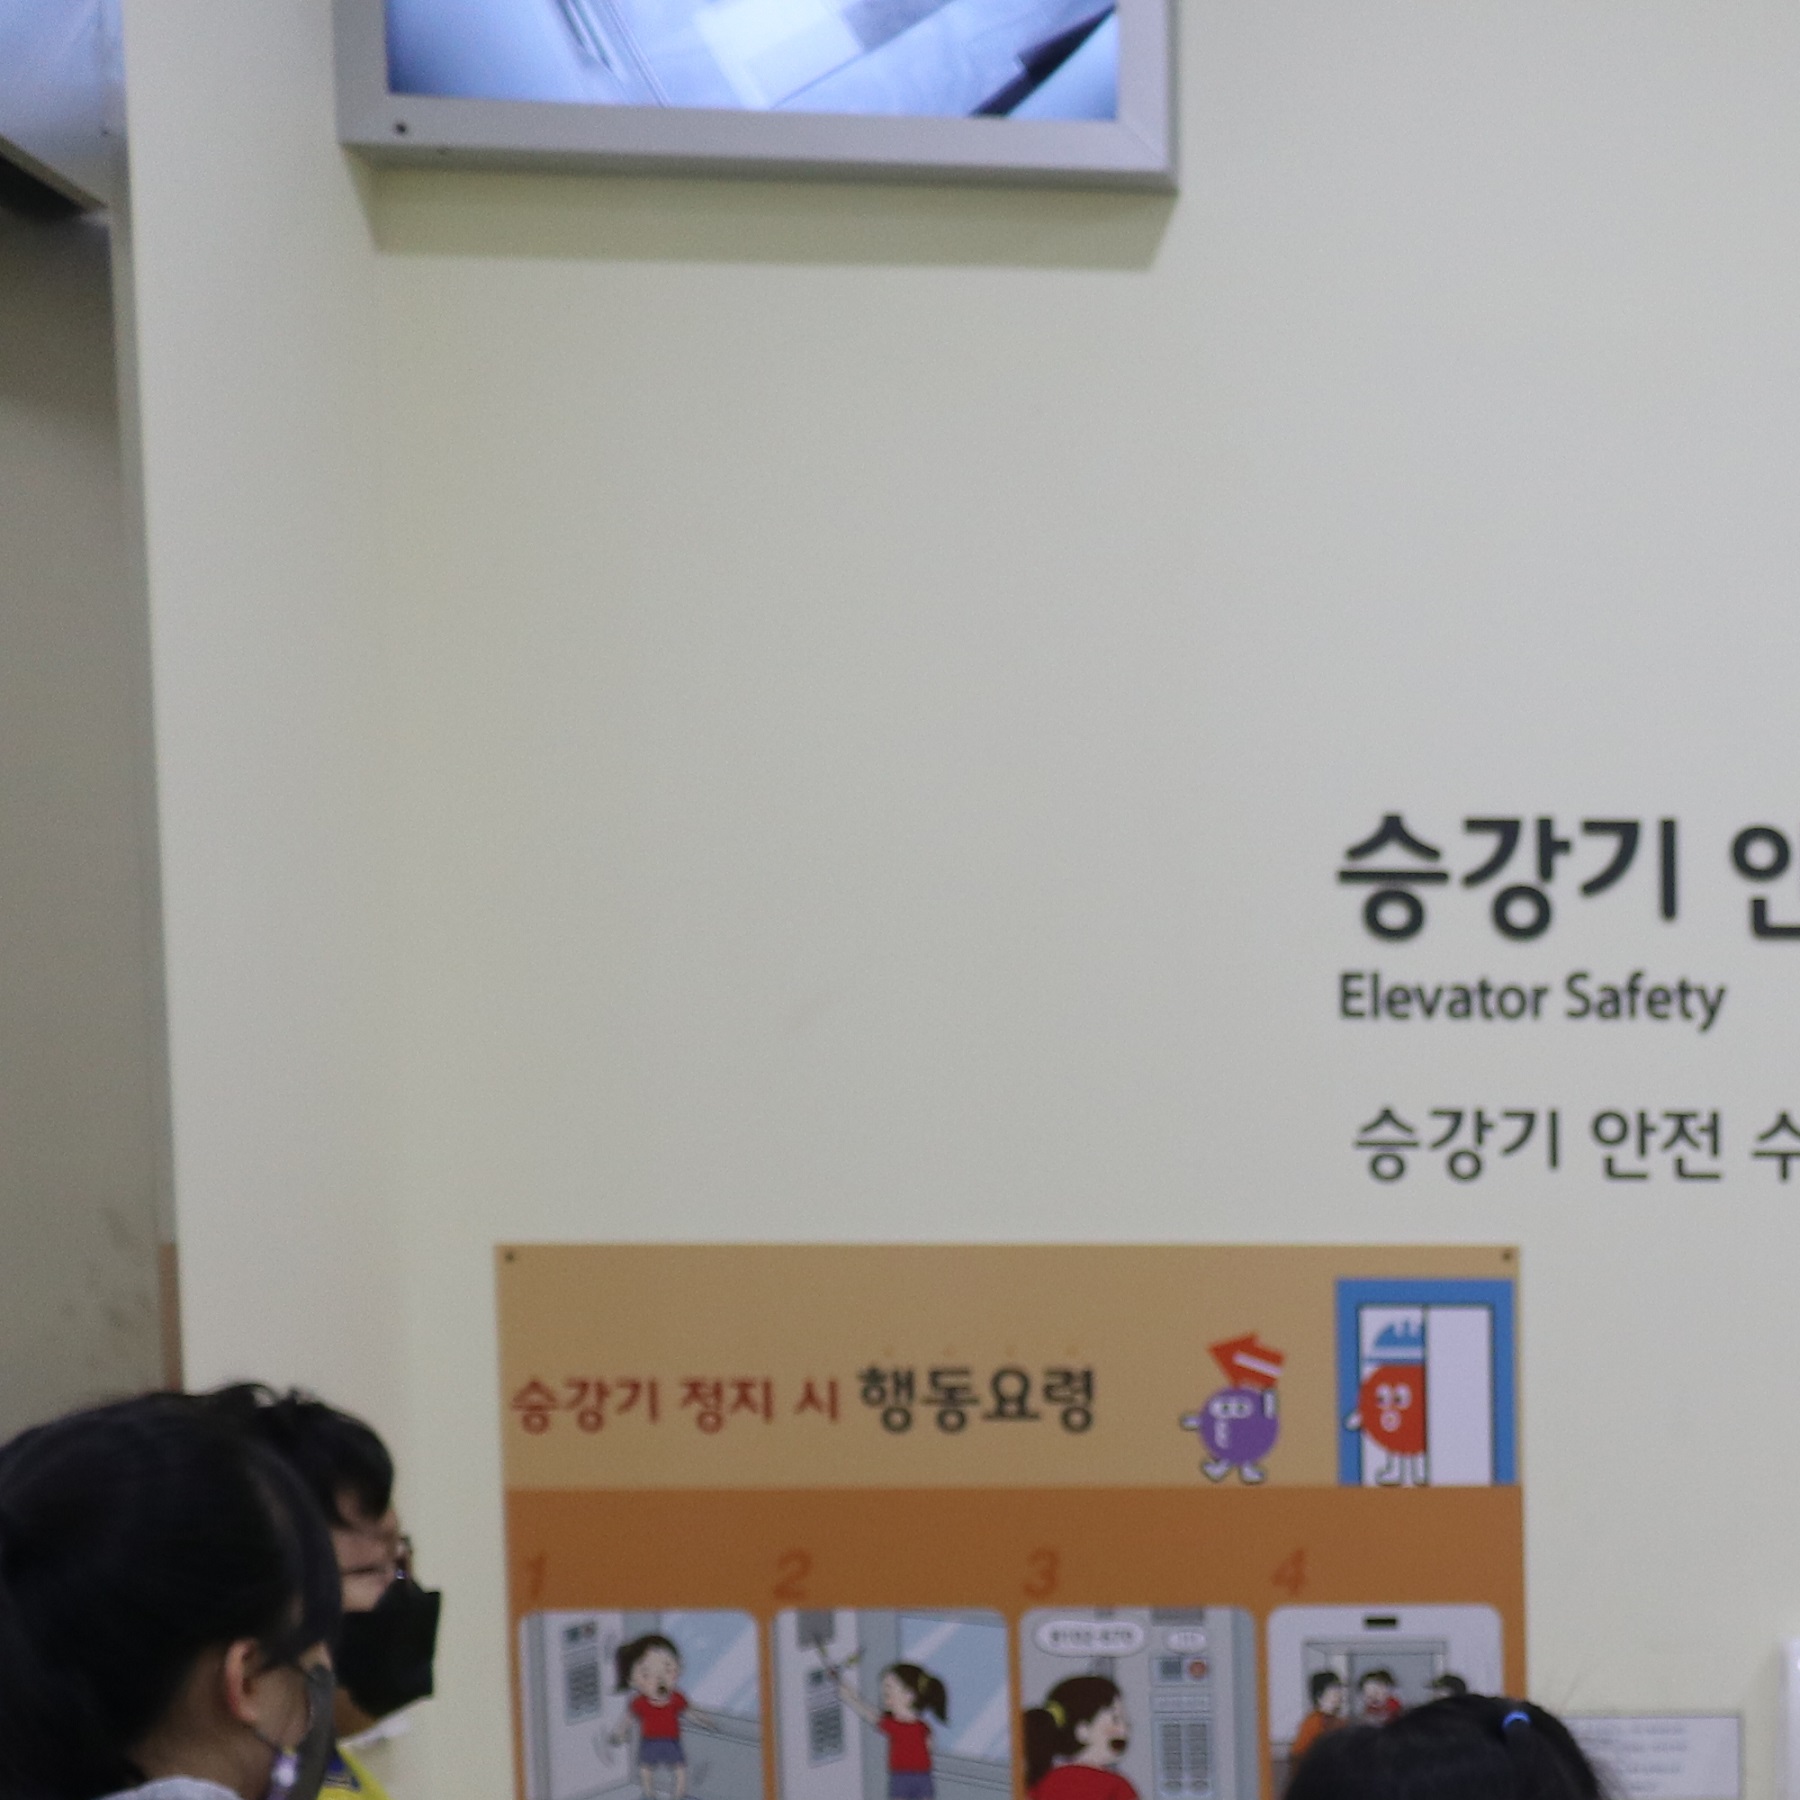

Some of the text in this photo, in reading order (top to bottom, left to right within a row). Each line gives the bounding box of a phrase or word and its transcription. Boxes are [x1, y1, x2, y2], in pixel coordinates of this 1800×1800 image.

[1337, 813, 1678, 943] 승강기
[1340, 970, 1727, 1033] Elevator Safety
[1355, 1107, 1559, 1183] 승강기
[1591, 1109, 1722, 1181] 안전
[512, 1364, 1096, 1435] 승강기 정지 시 행동요령
[526, 1555, 548, 1601] 1
[773, 1549, 812, 1600] 2
[1023, 1549, 1060, 1600] 3
[1271, 1548, 1306, 1598] 4
